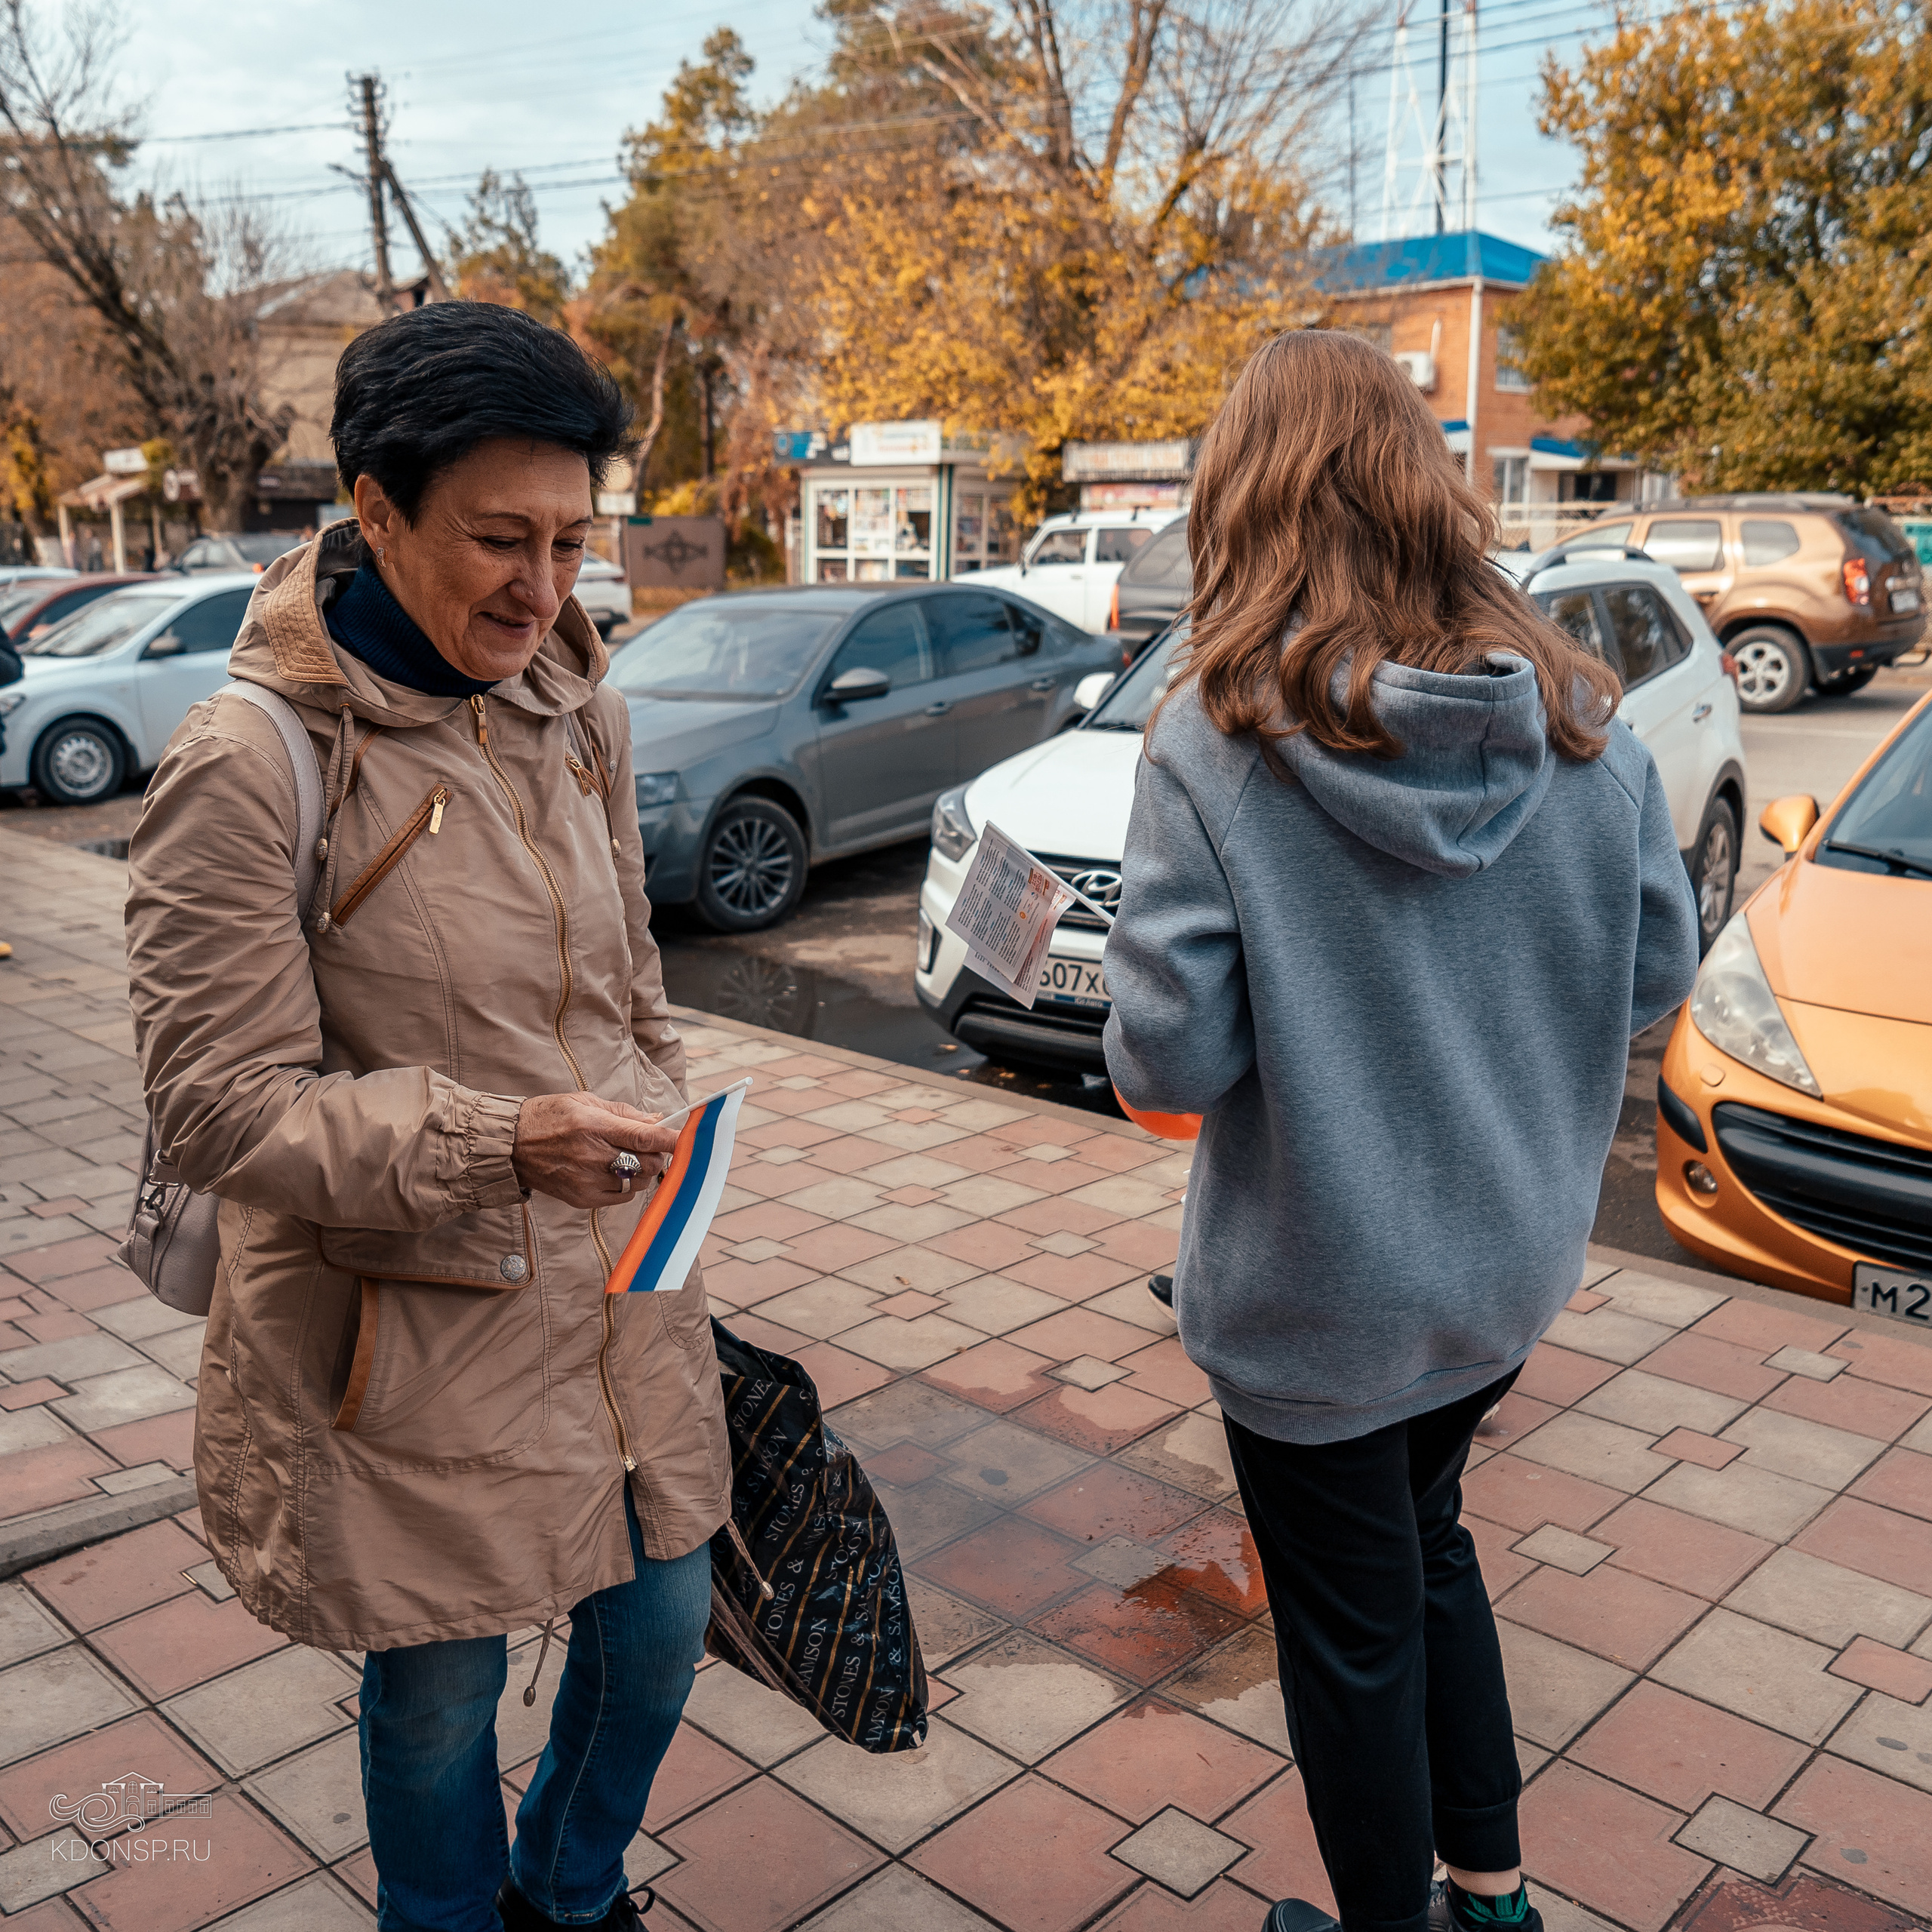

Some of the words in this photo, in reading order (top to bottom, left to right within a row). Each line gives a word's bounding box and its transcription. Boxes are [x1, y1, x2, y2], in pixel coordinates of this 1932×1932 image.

[787, 1558, 804, 1574] &
[888, 1554, 901, 1635] SAMSON
[888, 1647, 902, 1663] &
[830, 1656, 861, 1718] STONES
[865, 1688, 895, 1746] AMSON
